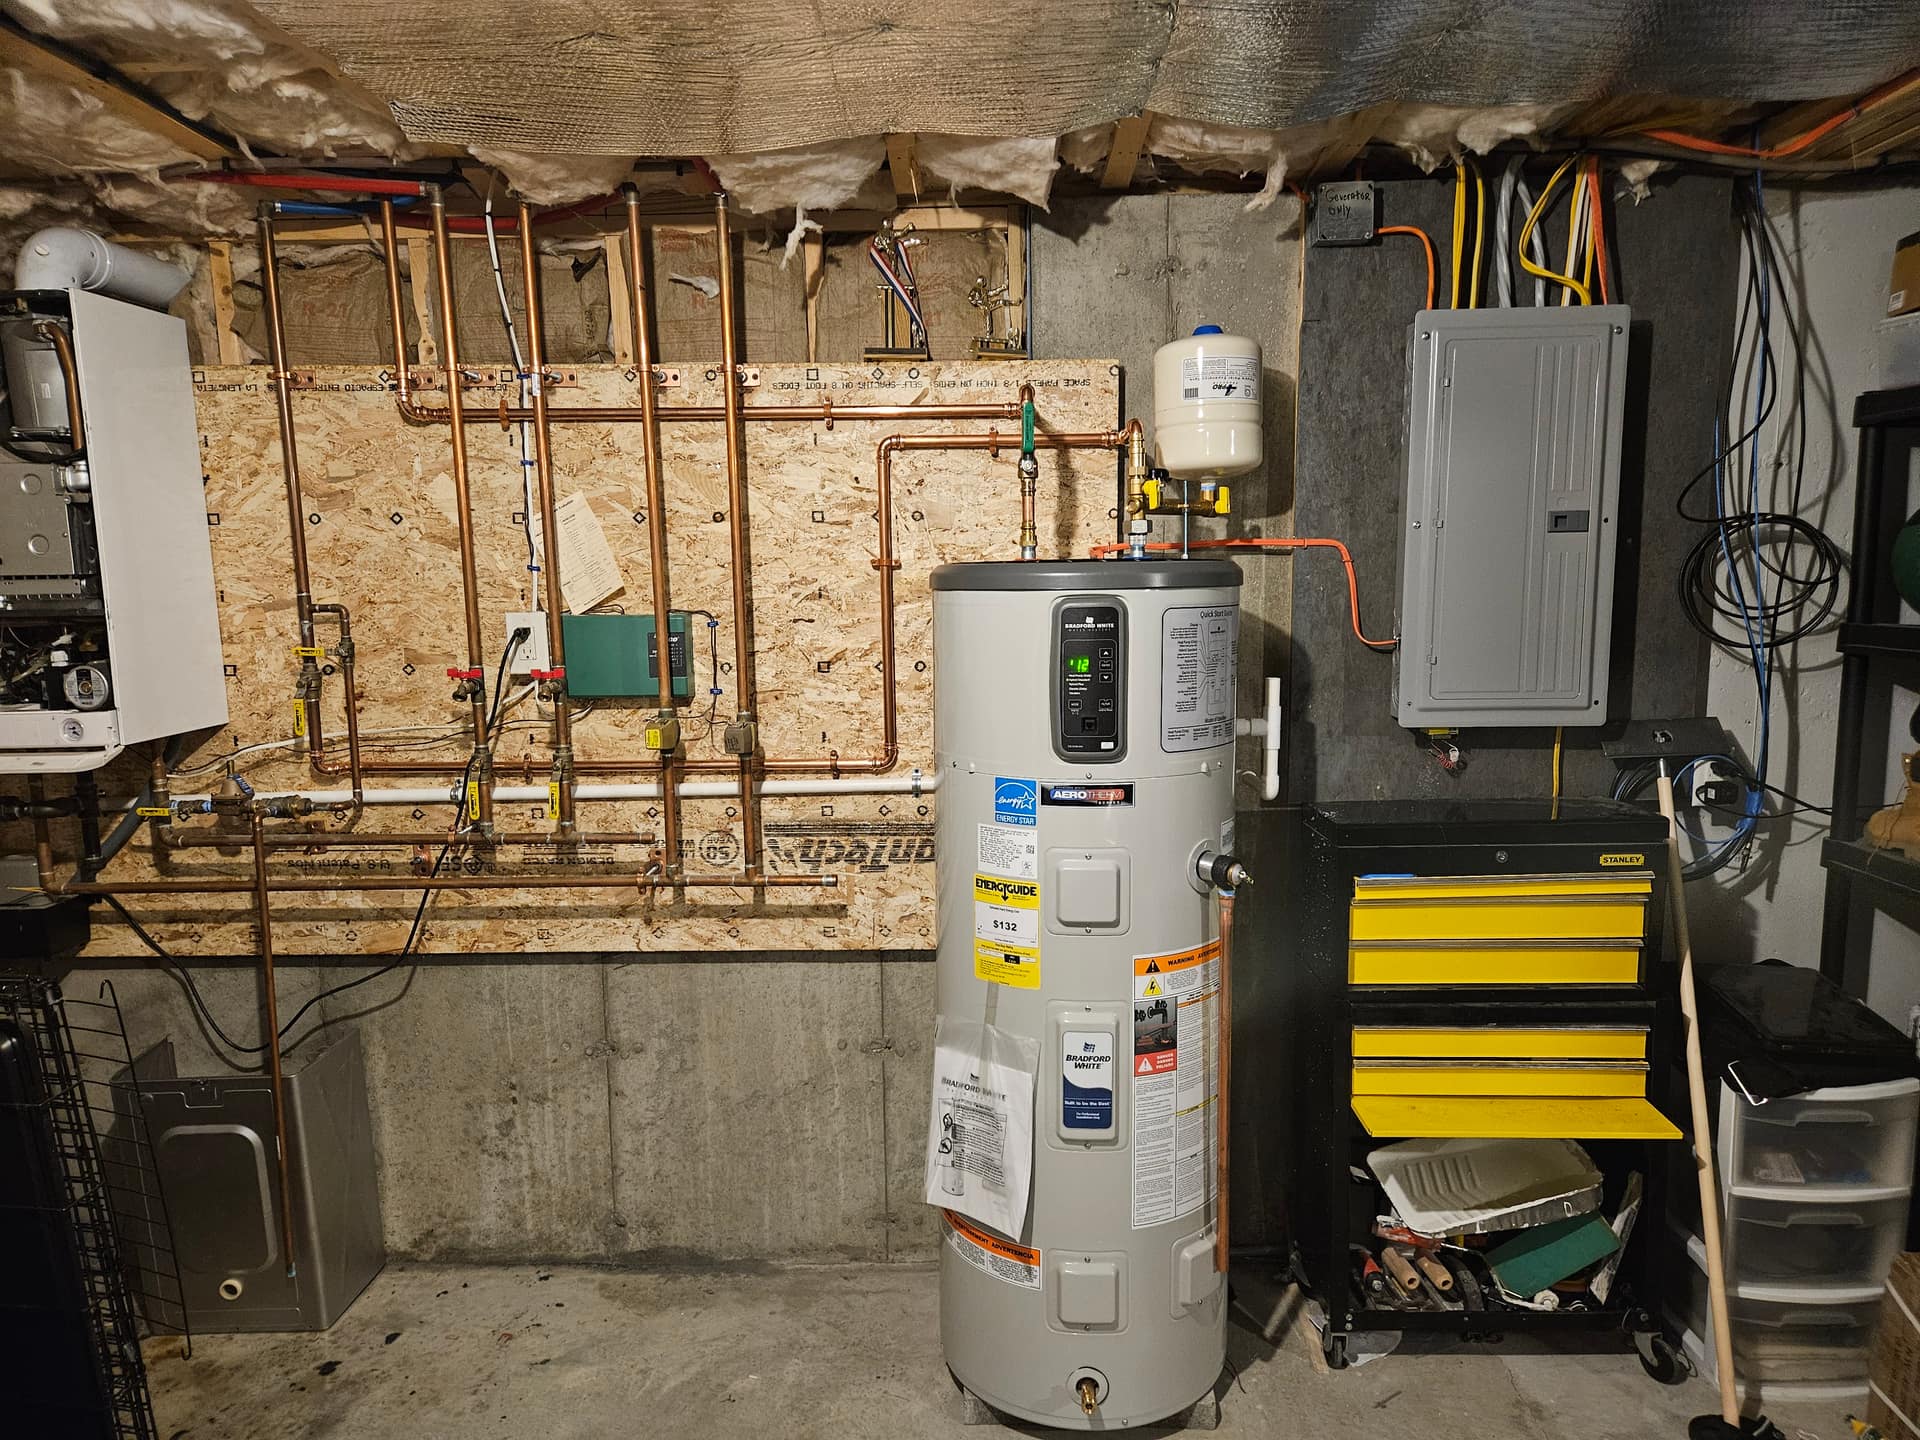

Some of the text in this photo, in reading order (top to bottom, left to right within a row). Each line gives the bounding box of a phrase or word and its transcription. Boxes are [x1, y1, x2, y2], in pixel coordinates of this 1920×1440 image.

[245, 383, 257, 392] LA
[772, 382, 800, 391] EDGES
[1063, 379, 1091, 387] SPACE
[996, 814, 1035, 825] ENERGY STAR
[1167, 955, 1195, 967] WARNING
[1065, 1054, 1111, 1063] BRADFORD
[1074, 1062, 1102, 1070] WHITE
